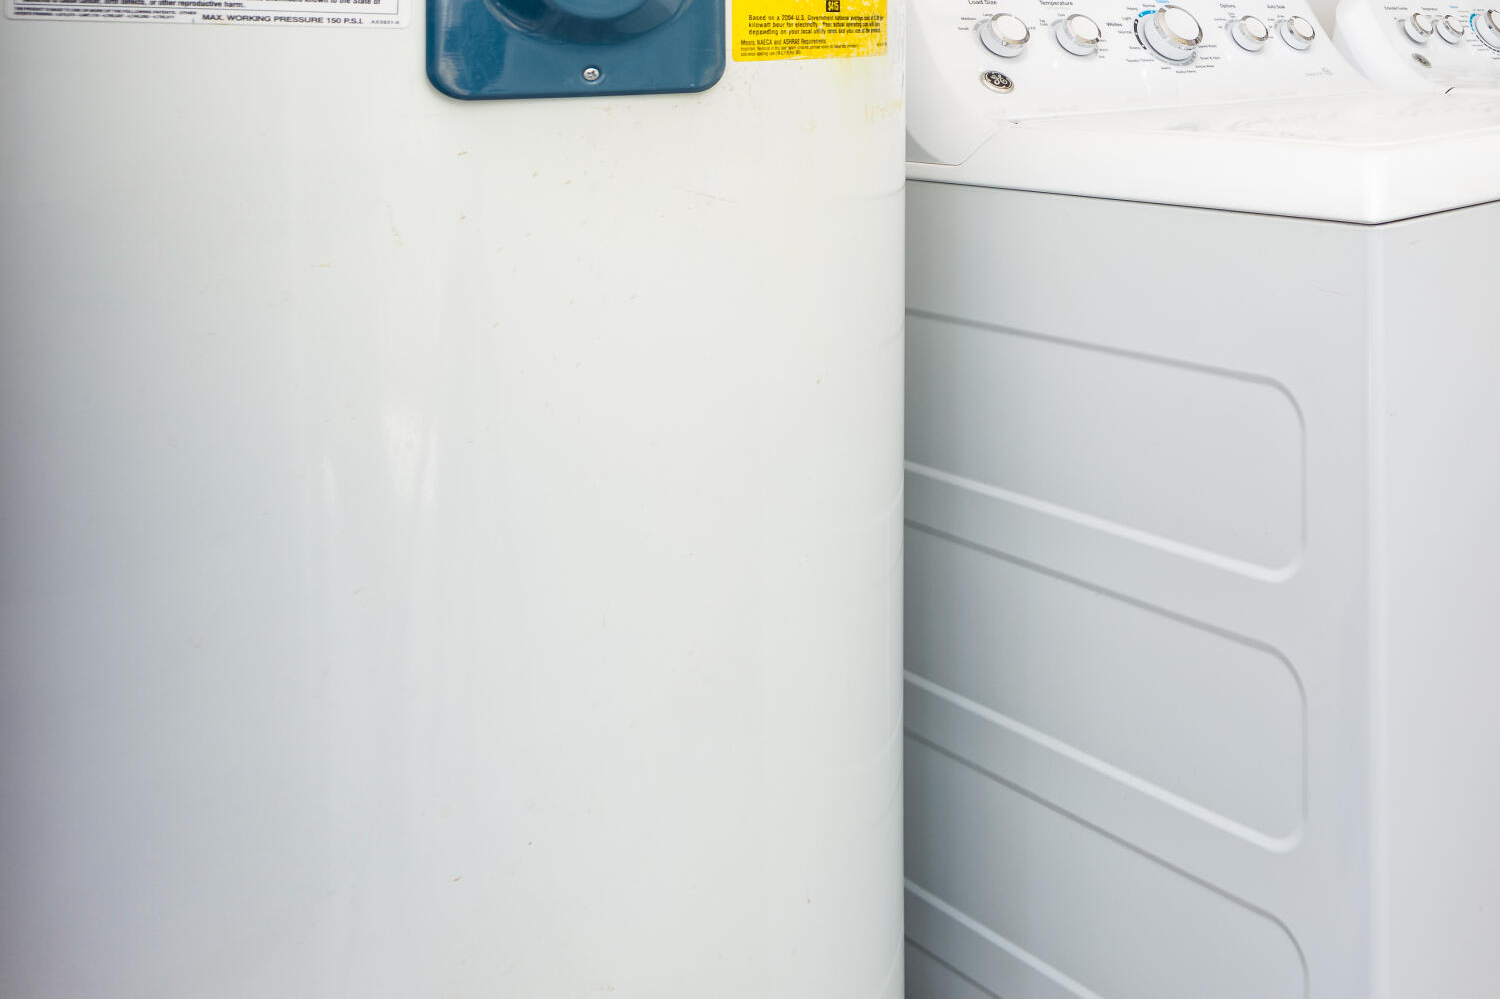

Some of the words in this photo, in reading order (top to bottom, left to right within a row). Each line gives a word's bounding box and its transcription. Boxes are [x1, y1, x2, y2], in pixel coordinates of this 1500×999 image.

[202, 13, 223, 21] MAX.
[227, 14, 271, 23] WORKING
[273, 15, 324, 25] PRESSURE
[327, 17, 341, 25] 150
[748, 14, 766, 22] Based
[748, 21, 771, 29] kilowatt
[748, 29, 778, 37] depending
